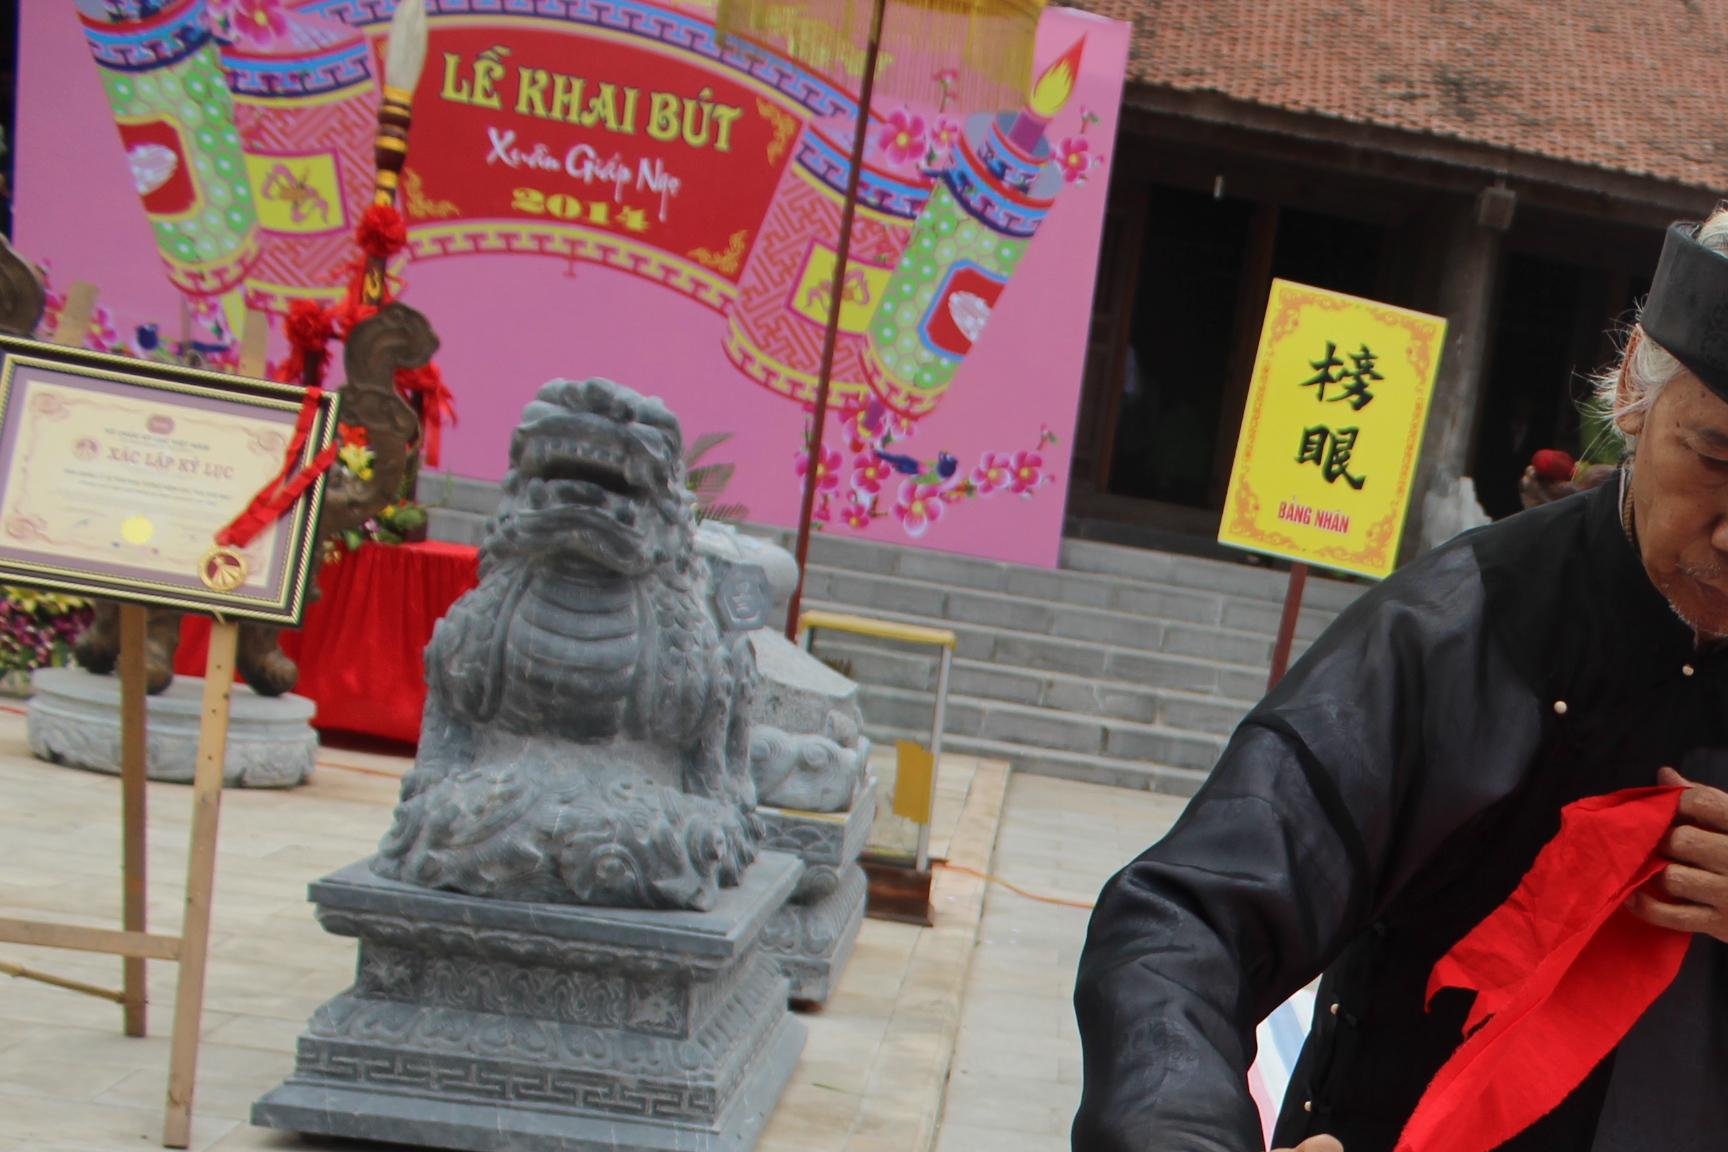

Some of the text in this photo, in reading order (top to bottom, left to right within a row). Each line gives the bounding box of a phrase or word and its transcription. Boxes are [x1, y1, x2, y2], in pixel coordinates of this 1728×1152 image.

[514, 66, 640, 135] KHAI
[646, 87, 742, 152] BÚT
[486, 126, 560, 169] Xuân
[564, 143, 632, 203] Giáp
[510, 187, 650, 233] 2014
[1294, 339, 1385, 490] 榜眼
